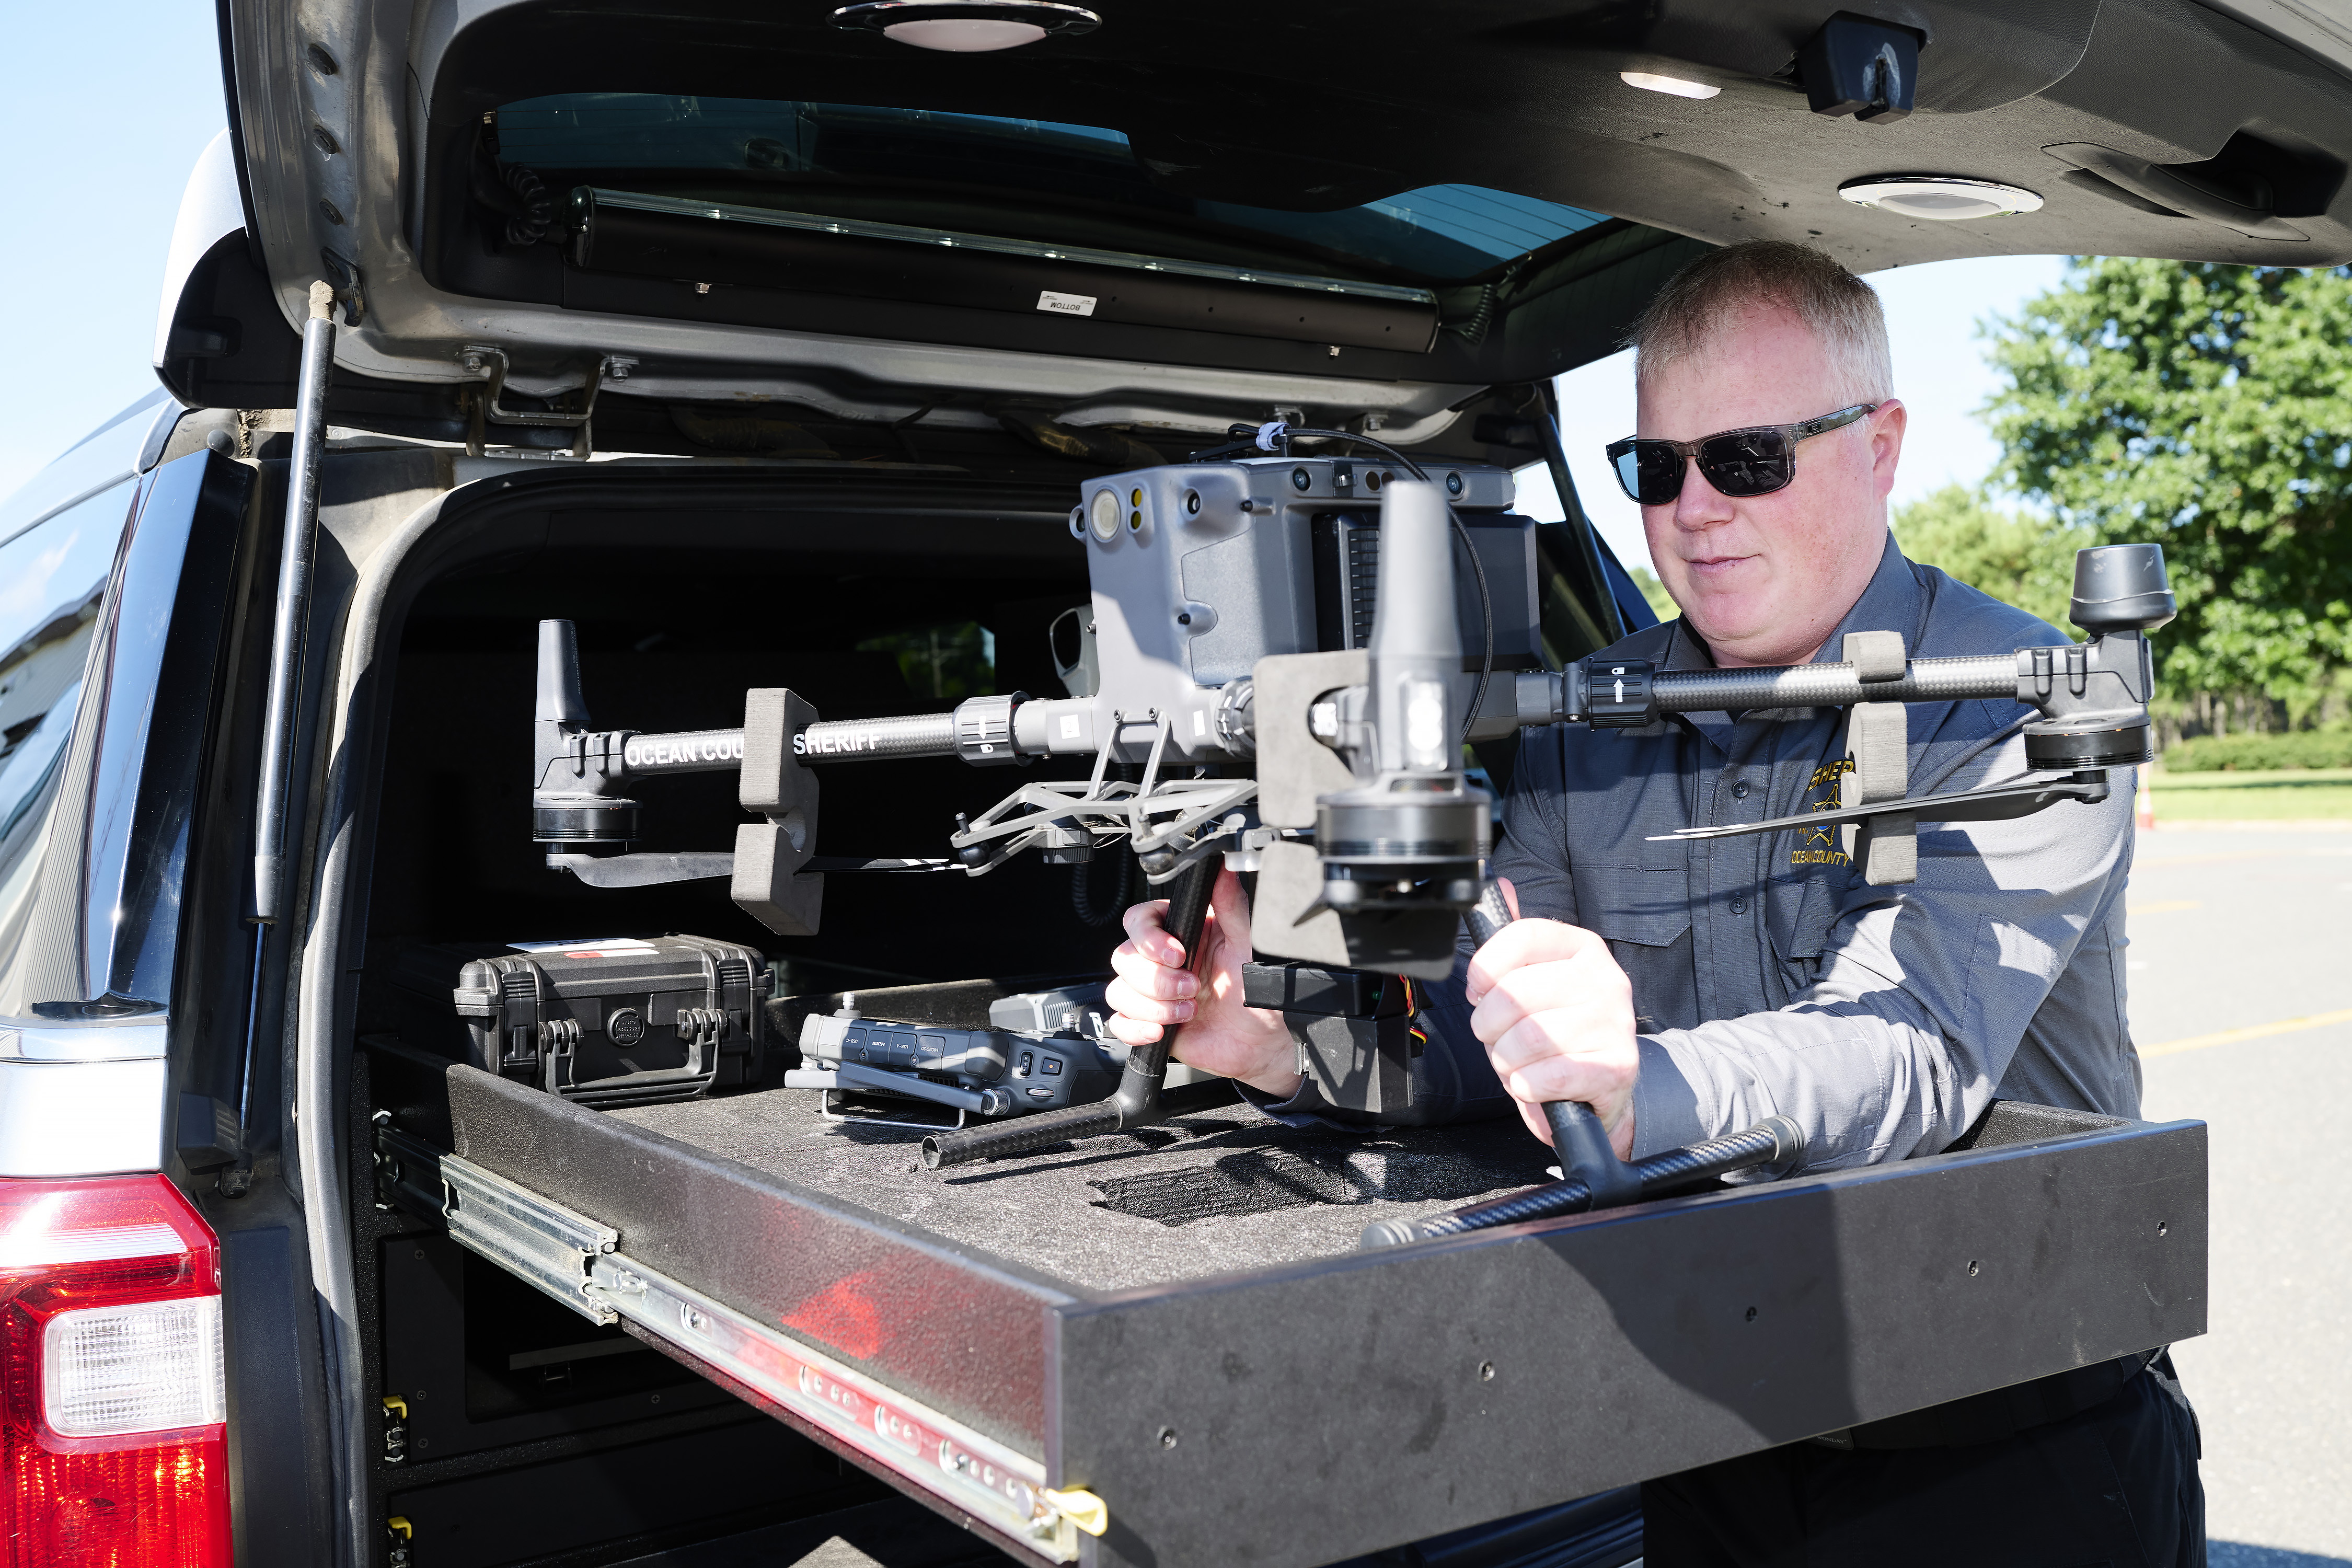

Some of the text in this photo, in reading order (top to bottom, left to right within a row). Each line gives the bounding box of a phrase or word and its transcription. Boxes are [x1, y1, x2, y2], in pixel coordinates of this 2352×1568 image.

[1051, 302, 1080, 311] BOTTOM
[626, 729, 882, 766] OCEAN COU SHERIFF
[1807, 760, 1856, 792] SHER
[1791, 850, 1850, 867] OCEAN COUNTY
